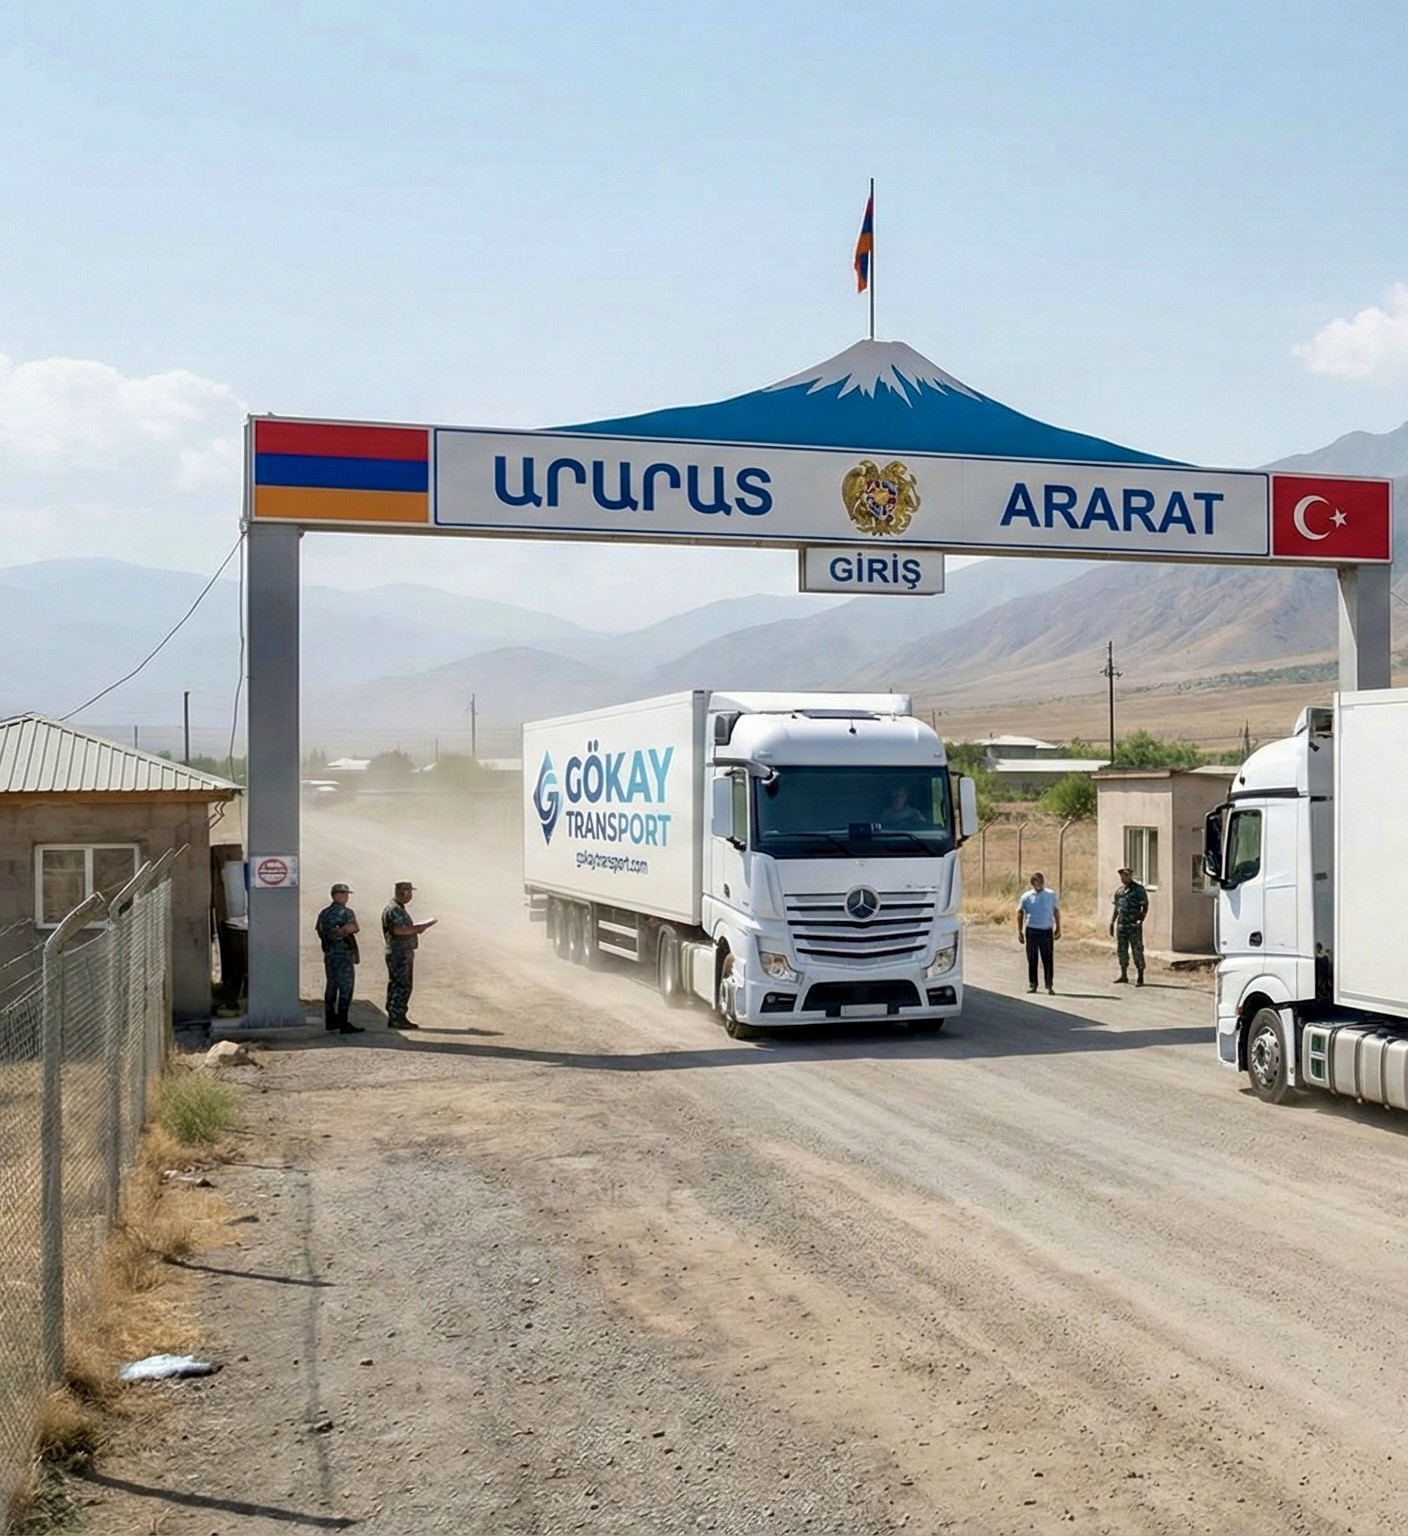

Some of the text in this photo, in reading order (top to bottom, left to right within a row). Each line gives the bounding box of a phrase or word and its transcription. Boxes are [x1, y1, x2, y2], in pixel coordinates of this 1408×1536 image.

[1000, 482, 1224, 535] ARARAT
[829, 552, 922, 590] GİRİŞ
[566, 740, 674, 803] GÖKAY
[566, 811, 671, 846] TRANSPORT
